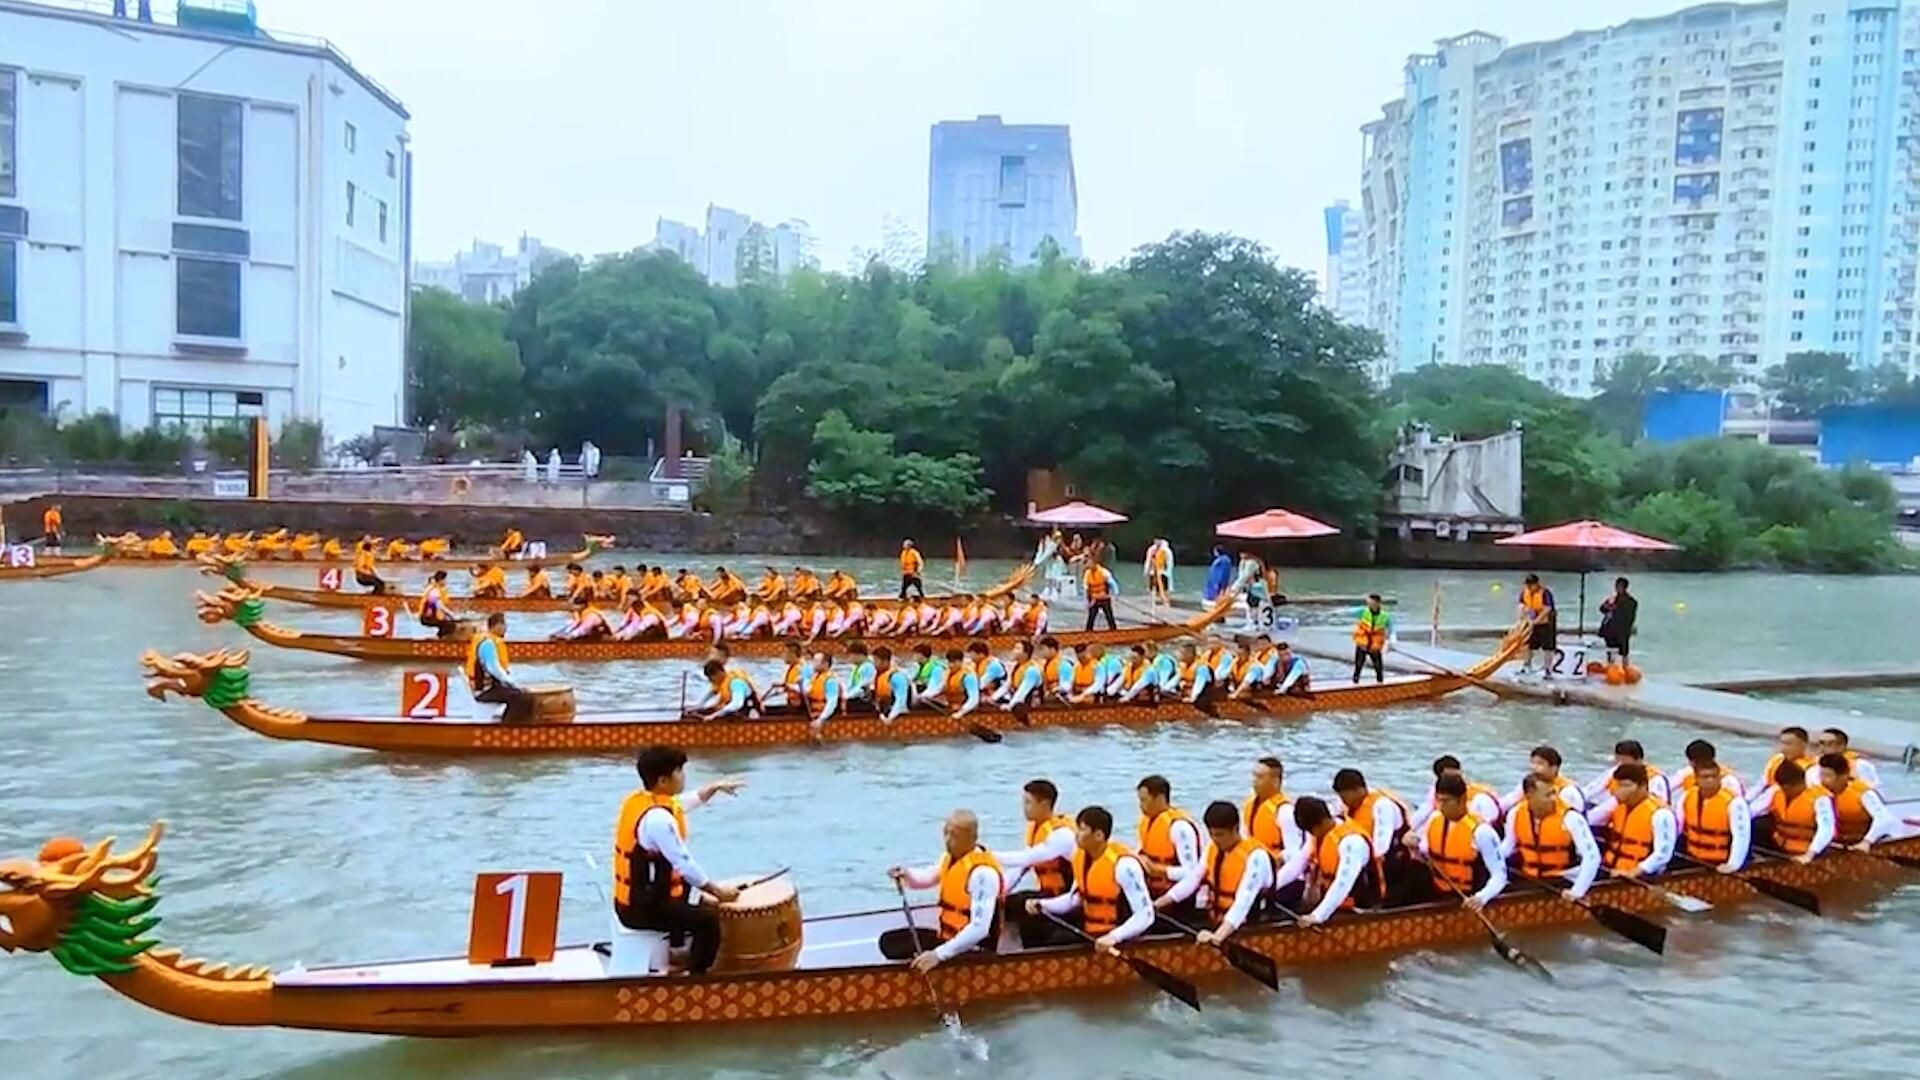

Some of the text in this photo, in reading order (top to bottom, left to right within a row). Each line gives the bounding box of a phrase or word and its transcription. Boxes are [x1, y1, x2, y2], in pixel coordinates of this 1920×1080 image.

[17, 547, 30, 563] 3
[321, 568, 339, 589] 4
[370, 606, 389, 636] 3
[1262, 606, 1273, 626] 3
[1552, 648, 1565, 674] 2
[1572, 651, 1585, 675] 2
[410, 673, 440, 716] 2
[496, 874, 528, 959] 1
